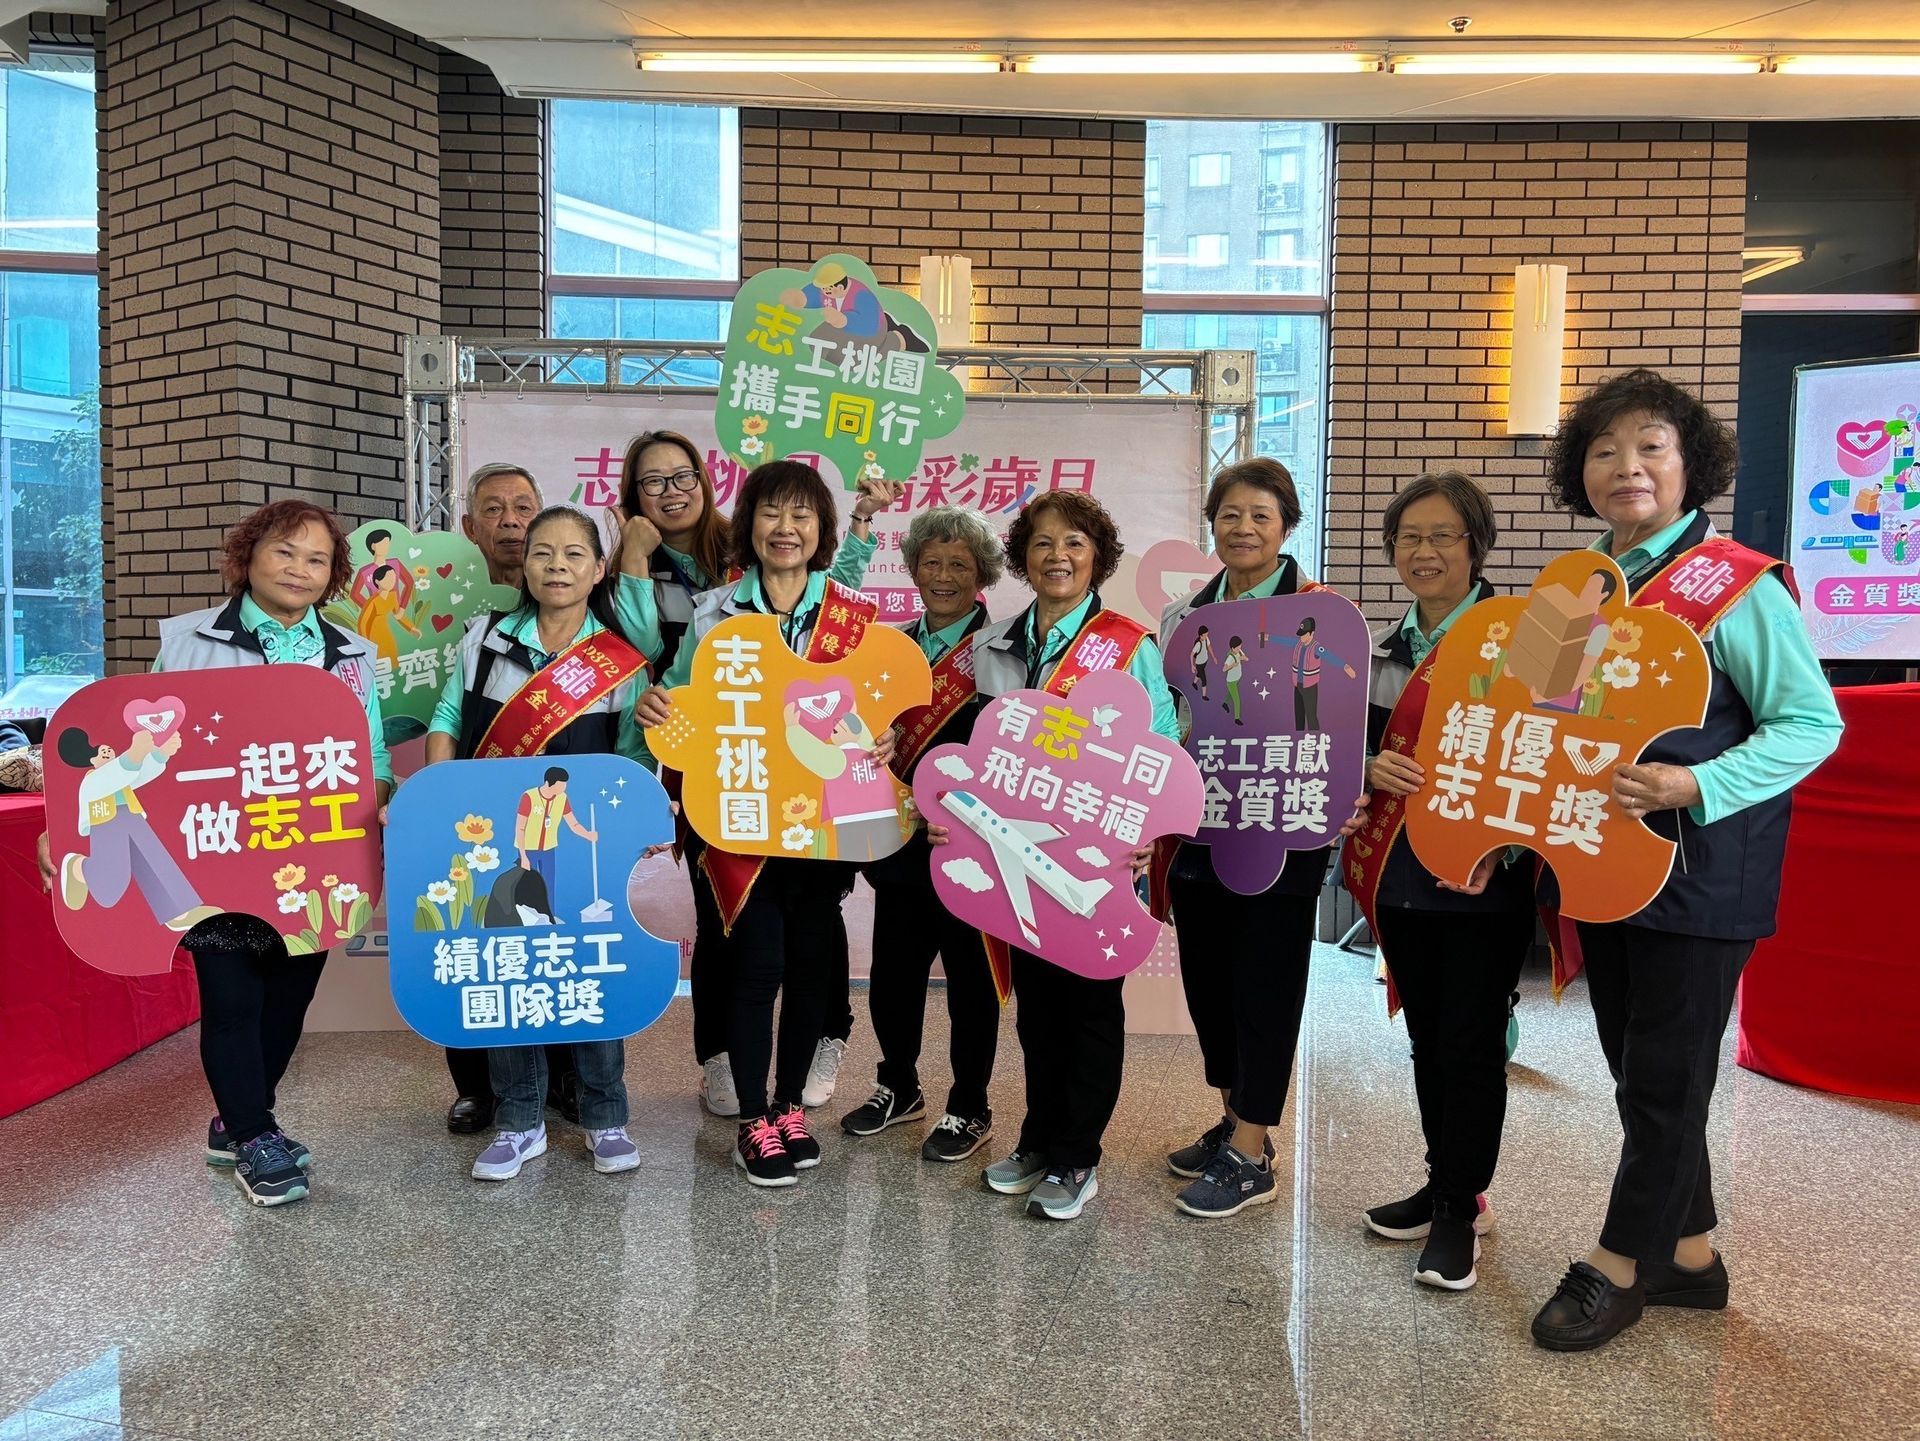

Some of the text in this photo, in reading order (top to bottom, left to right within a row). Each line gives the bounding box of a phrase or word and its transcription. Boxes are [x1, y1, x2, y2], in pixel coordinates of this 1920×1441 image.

[746, 302, 926, 396] 志工桃園
[729, 360, 921, 446] 攜手同行
[1829, 582, 1920, 607] 金質獎
[175, 736, 361, 798] 一起來
[712, 634, 770, 842] 志工桃園
[996, 696, 1173, 796] 有志一同
[1197, 732, 1331, 774] 志工貢獻
[1437, 700, 1559, 779] 績優
[179, 792, 366, 860] 做志工
[979, 746, 1151, 847] 飛向幸福
[1203, 776, 1330, 834] 金質獎
[1426, 760, 1610, 856] 志工獎
[432, 932, 627, 984] 績優志工
[462, 981, 605, 1030] 團隊獎
